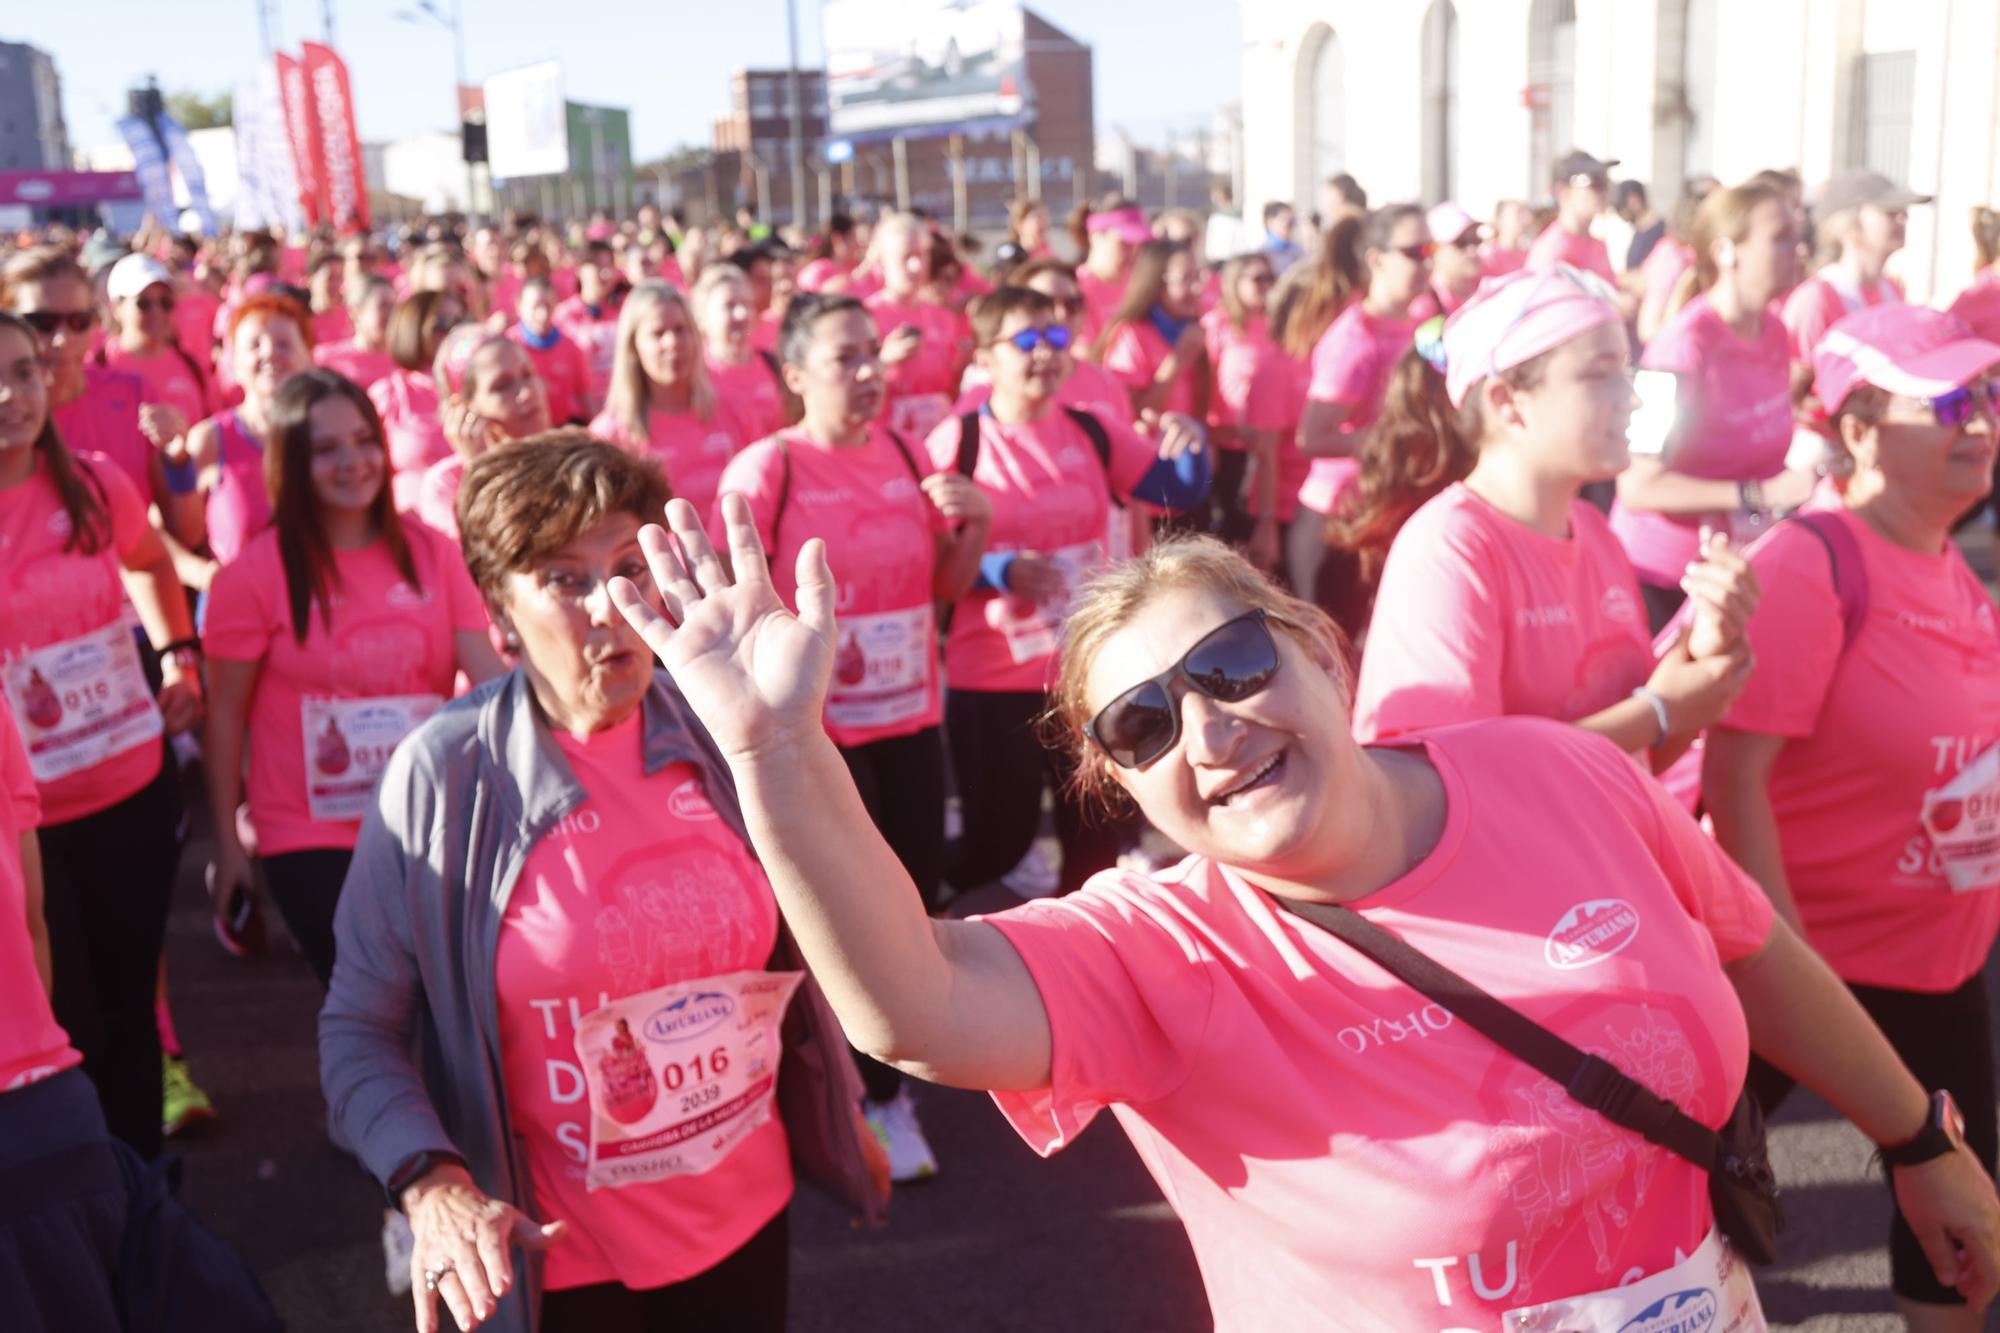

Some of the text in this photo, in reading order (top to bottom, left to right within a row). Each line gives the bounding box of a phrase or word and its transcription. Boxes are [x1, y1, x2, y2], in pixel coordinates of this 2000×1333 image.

[1337, 1003, 1453, 1053] OYSHO
[663, 1046, 729, 1091] 016
[680, 1084, 721, 1113] 2039
[1413, 1240, 1518, 1307] TU
